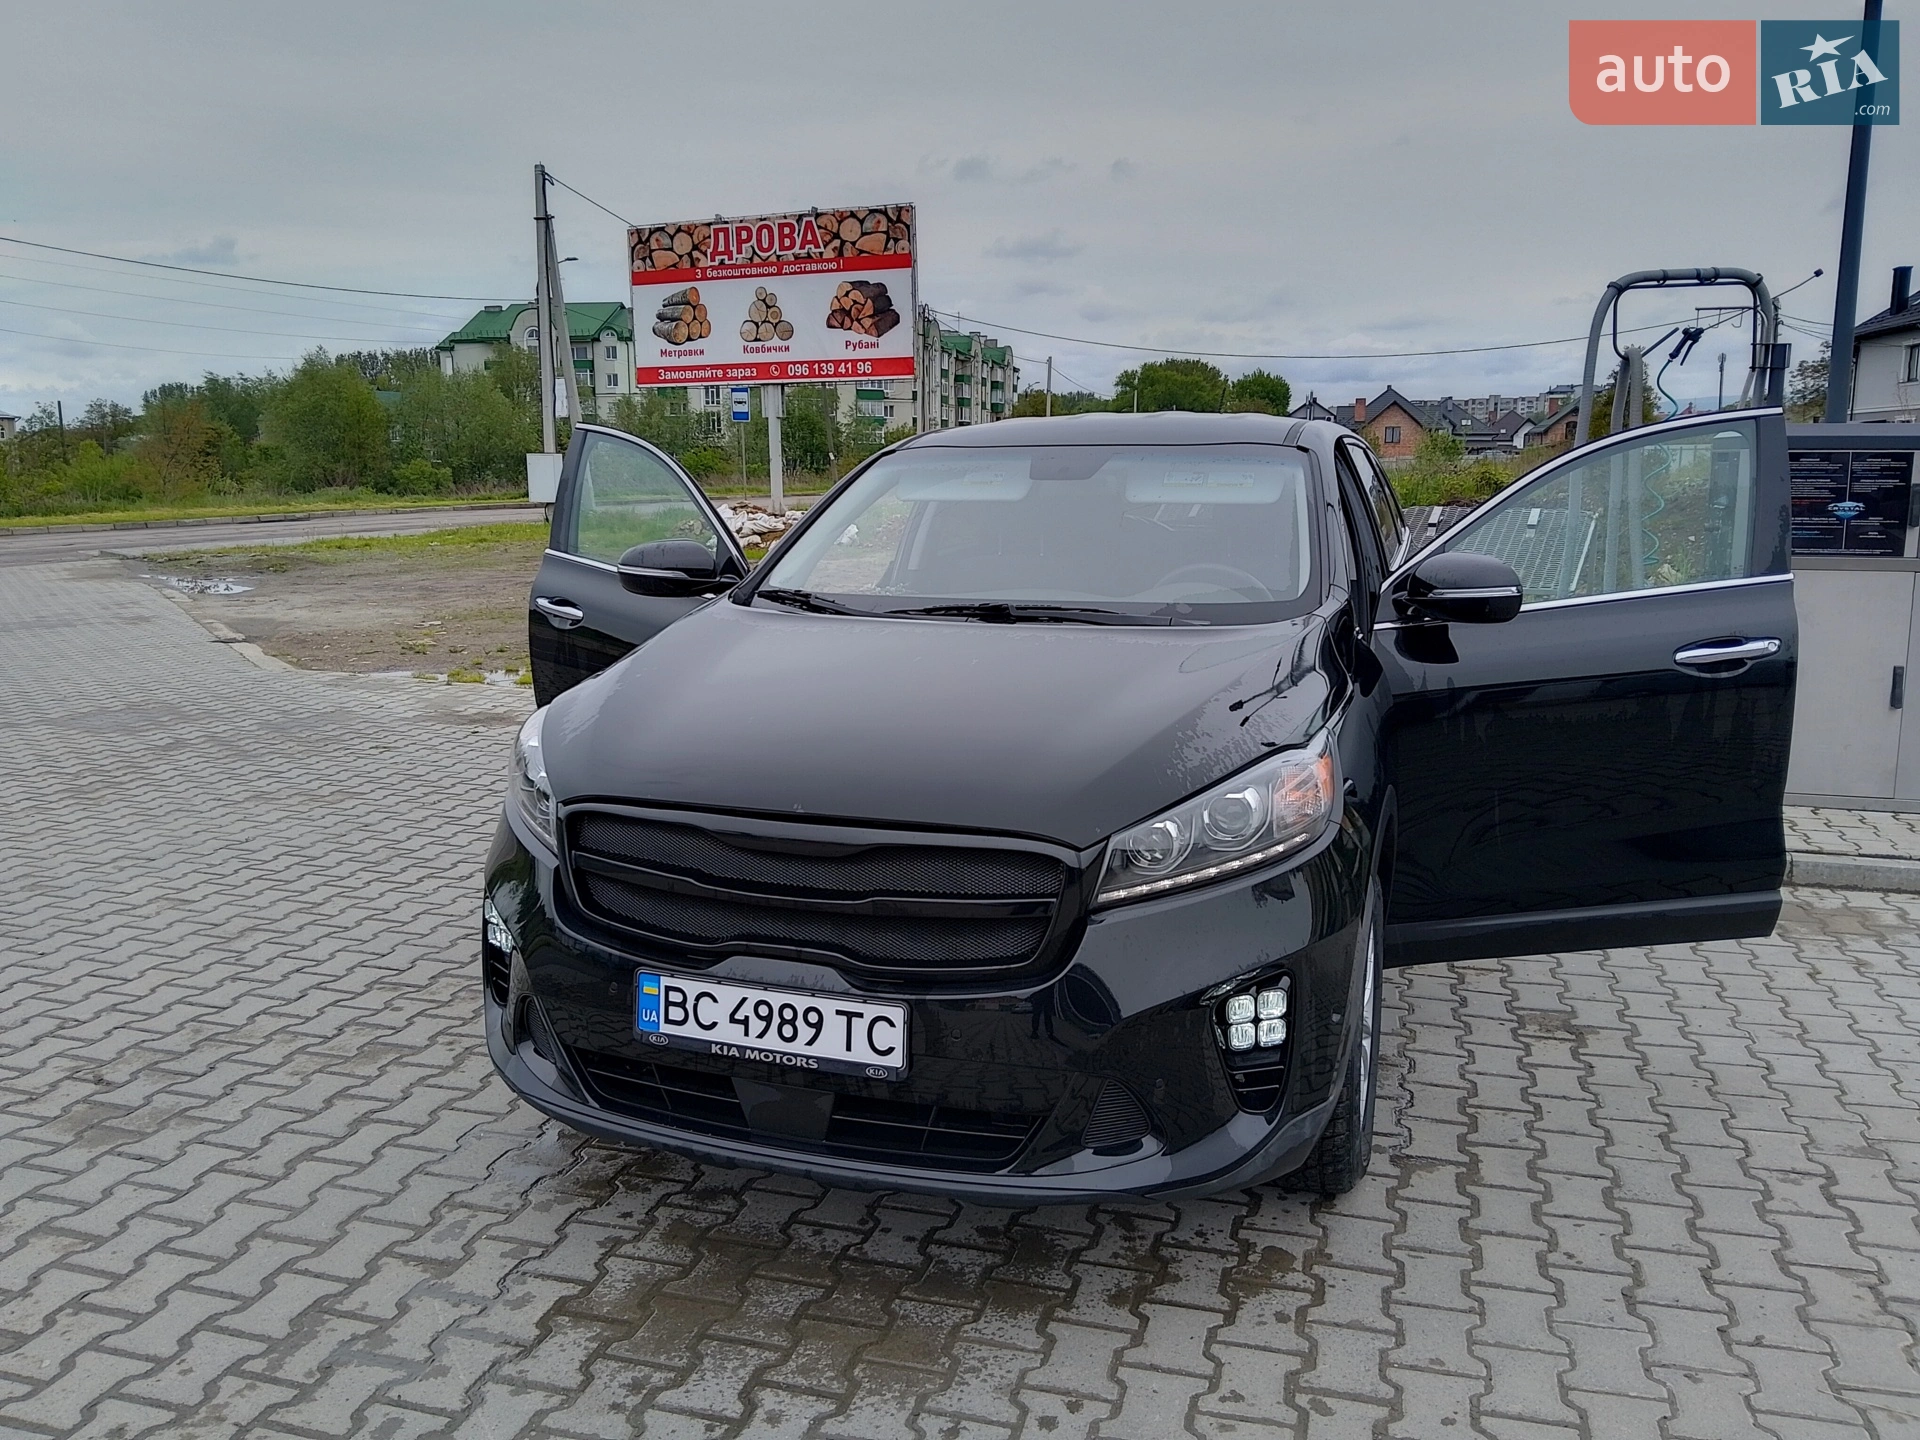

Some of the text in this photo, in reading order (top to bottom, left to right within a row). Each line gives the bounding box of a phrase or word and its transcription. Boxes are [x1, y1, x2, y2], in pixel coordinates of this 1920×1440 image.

[708, 218, 824, 264] ДРОВА
[706, 265, 778, 278] безкоштовною
[782, 261, 837, 274] доставкою
[743, 344, 790, 354] Ковбички
[845, 339, 880, 352] Рубані
[660, 348, 705, 359] Метровки
[658, 367, 757, 380] Замовляйте зараз
[787, 361, 872, 376] 096 139 41 96
[642, 1008, 658, 1024] UA
[664, 984, 897, 1057] BC 4989 TC
[651, 1035, 667, 1044] KIA
[711, 1043, 819, 1069] KIA MOTORS
[869, 1067, 886, 1076] KIA
